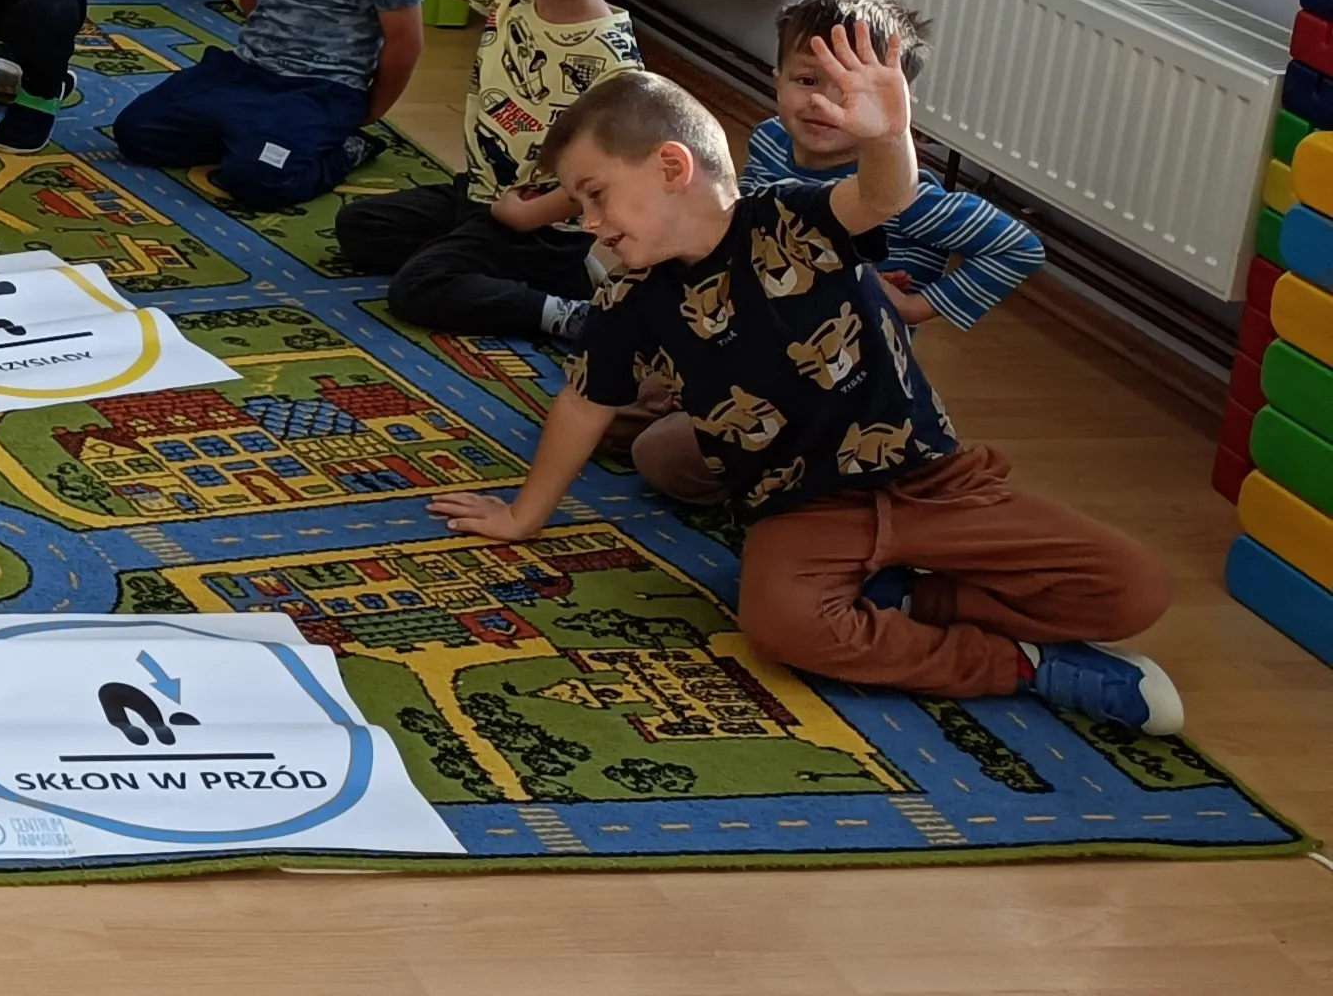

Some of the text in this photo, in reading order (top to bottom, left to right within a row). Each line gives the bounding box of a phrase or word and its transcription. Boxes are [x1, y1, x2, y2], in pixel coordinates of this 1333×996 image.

[14, 764, 328, 792] SKŁON W PRZÓD
